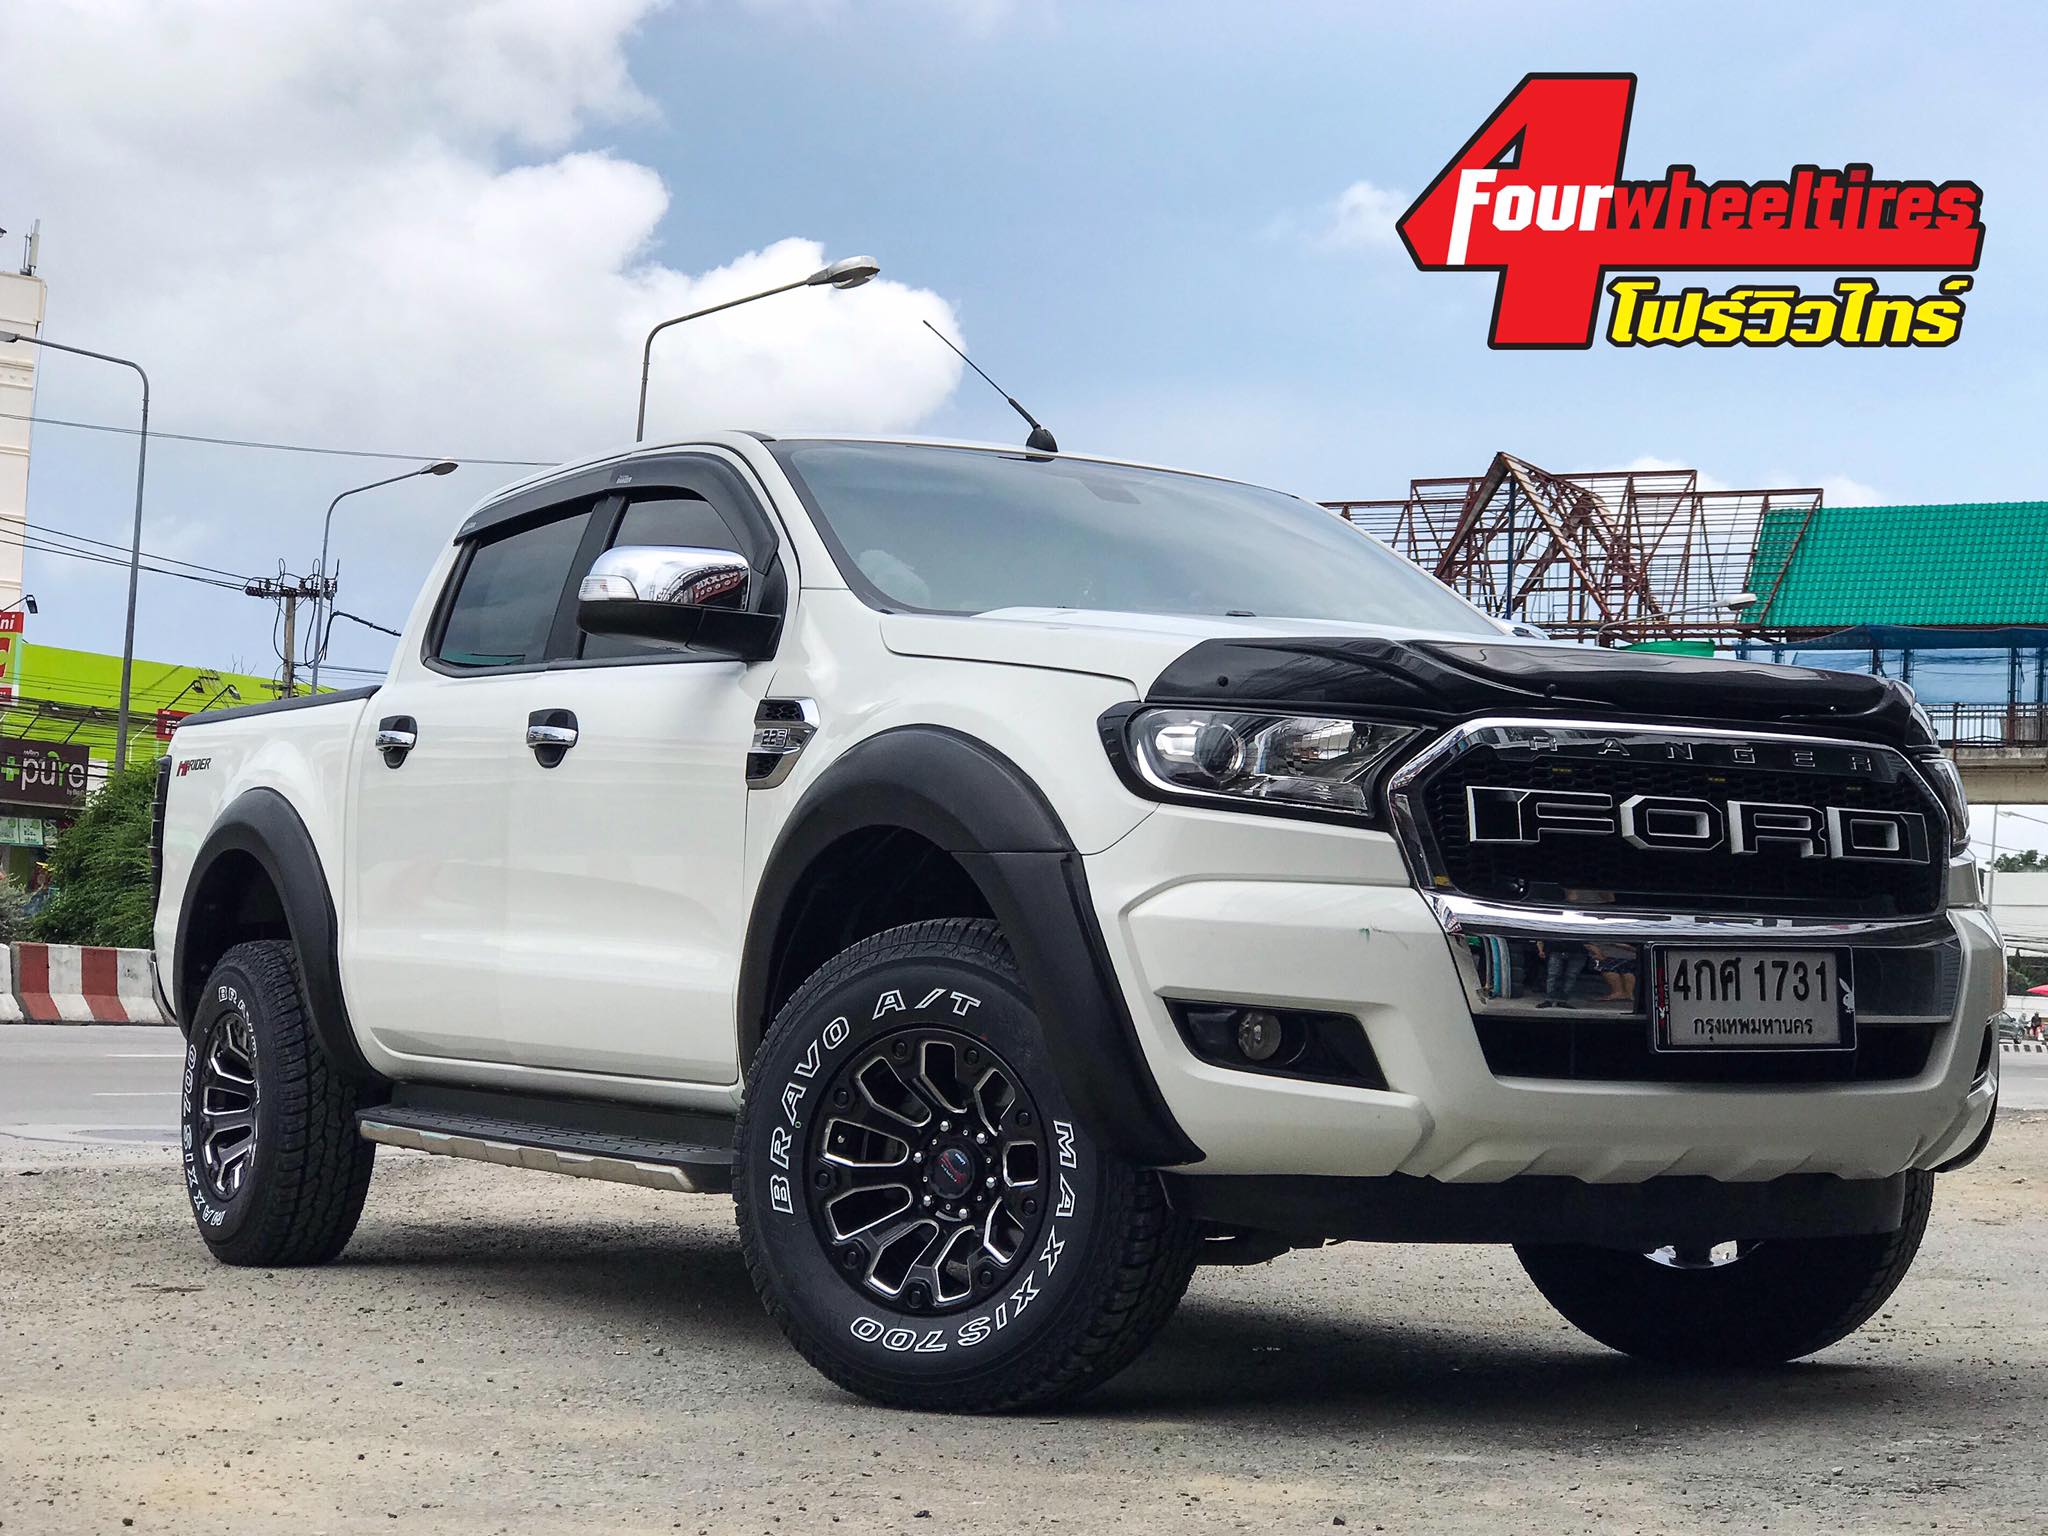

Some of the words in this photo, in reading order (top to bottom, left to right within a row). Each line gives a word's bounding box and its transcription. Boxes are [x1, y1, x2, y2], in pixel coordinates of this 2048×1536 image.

[0, 614, 15, 630] ni
[1528, 736, 1873, 772] RANGER
[1466, 785, 1931, 865] FORD
[1672, 956, 1742, 1002] 4กศ
[1753, 959, 1828, 1002] 1731
[1693, 1017, 1814, 1041] กรุงเทพมหานคร
[182, 1043, 198, 1117] 700
[769, 1016, 850, 1215] BRAVO
[872, 988, 981, 1019] A/T
[182, 1125, 226, 1227] MAXXIS
[956, 1119, 1078, 1347] MAXXIS
[850, 1315, 948, 1353] 700
